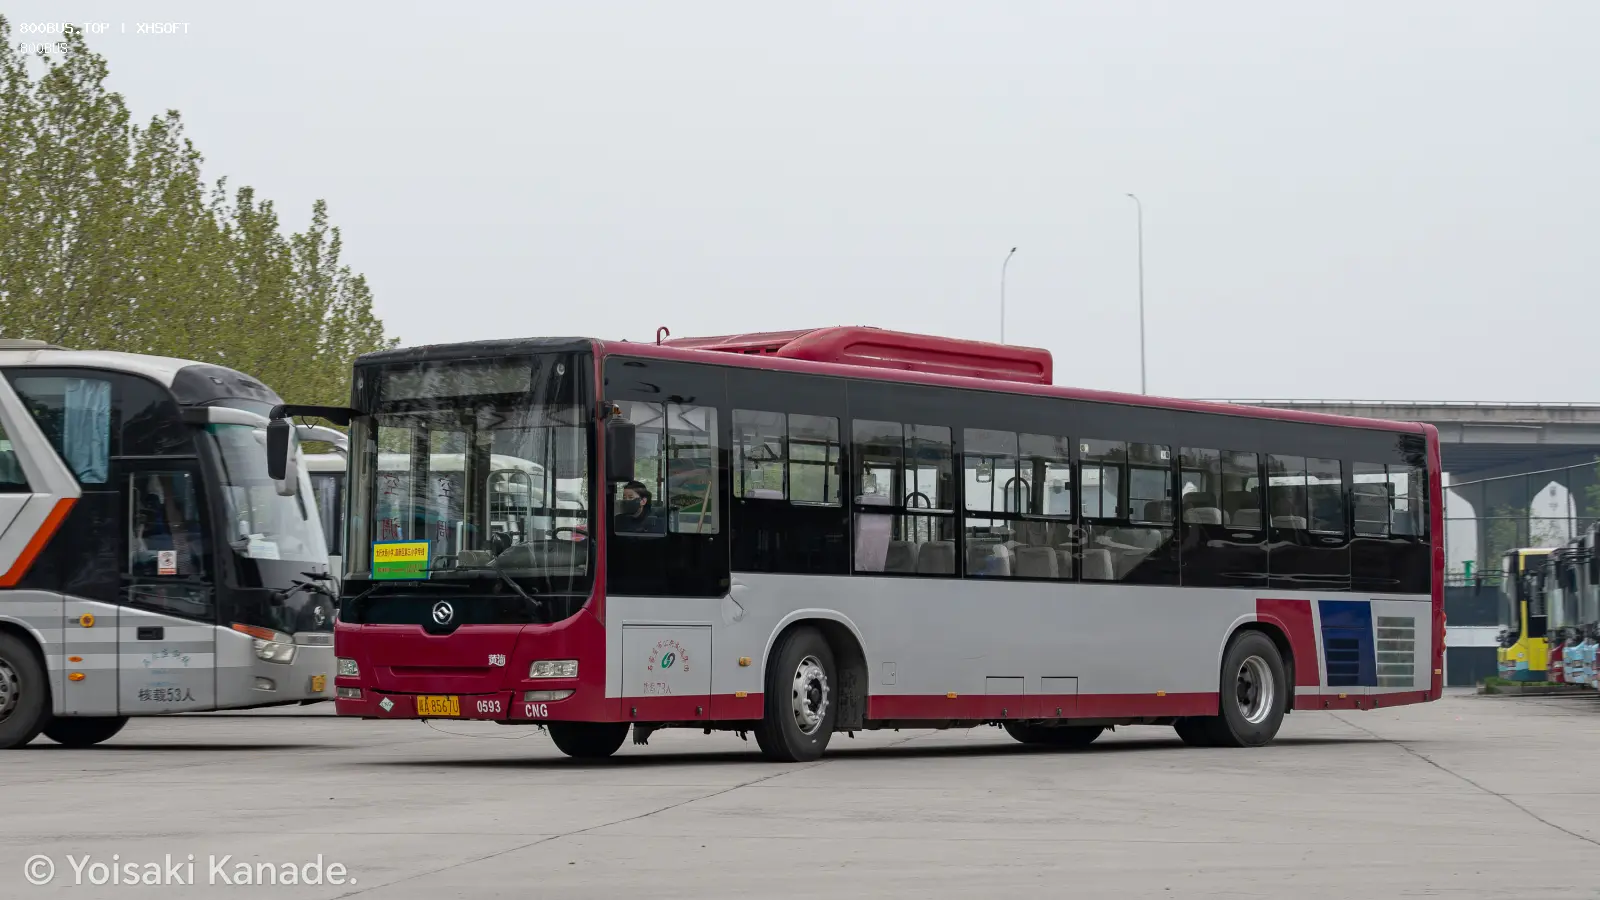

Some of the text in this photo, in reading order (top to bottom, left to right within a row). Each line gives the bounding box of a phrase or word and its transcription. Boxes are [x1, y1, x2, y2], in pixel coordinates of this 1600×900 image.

[137, 688, 196, 702] 核载53人
[476, 699, 501, 714] 0593
[525, 703, 548, 718] CNG
